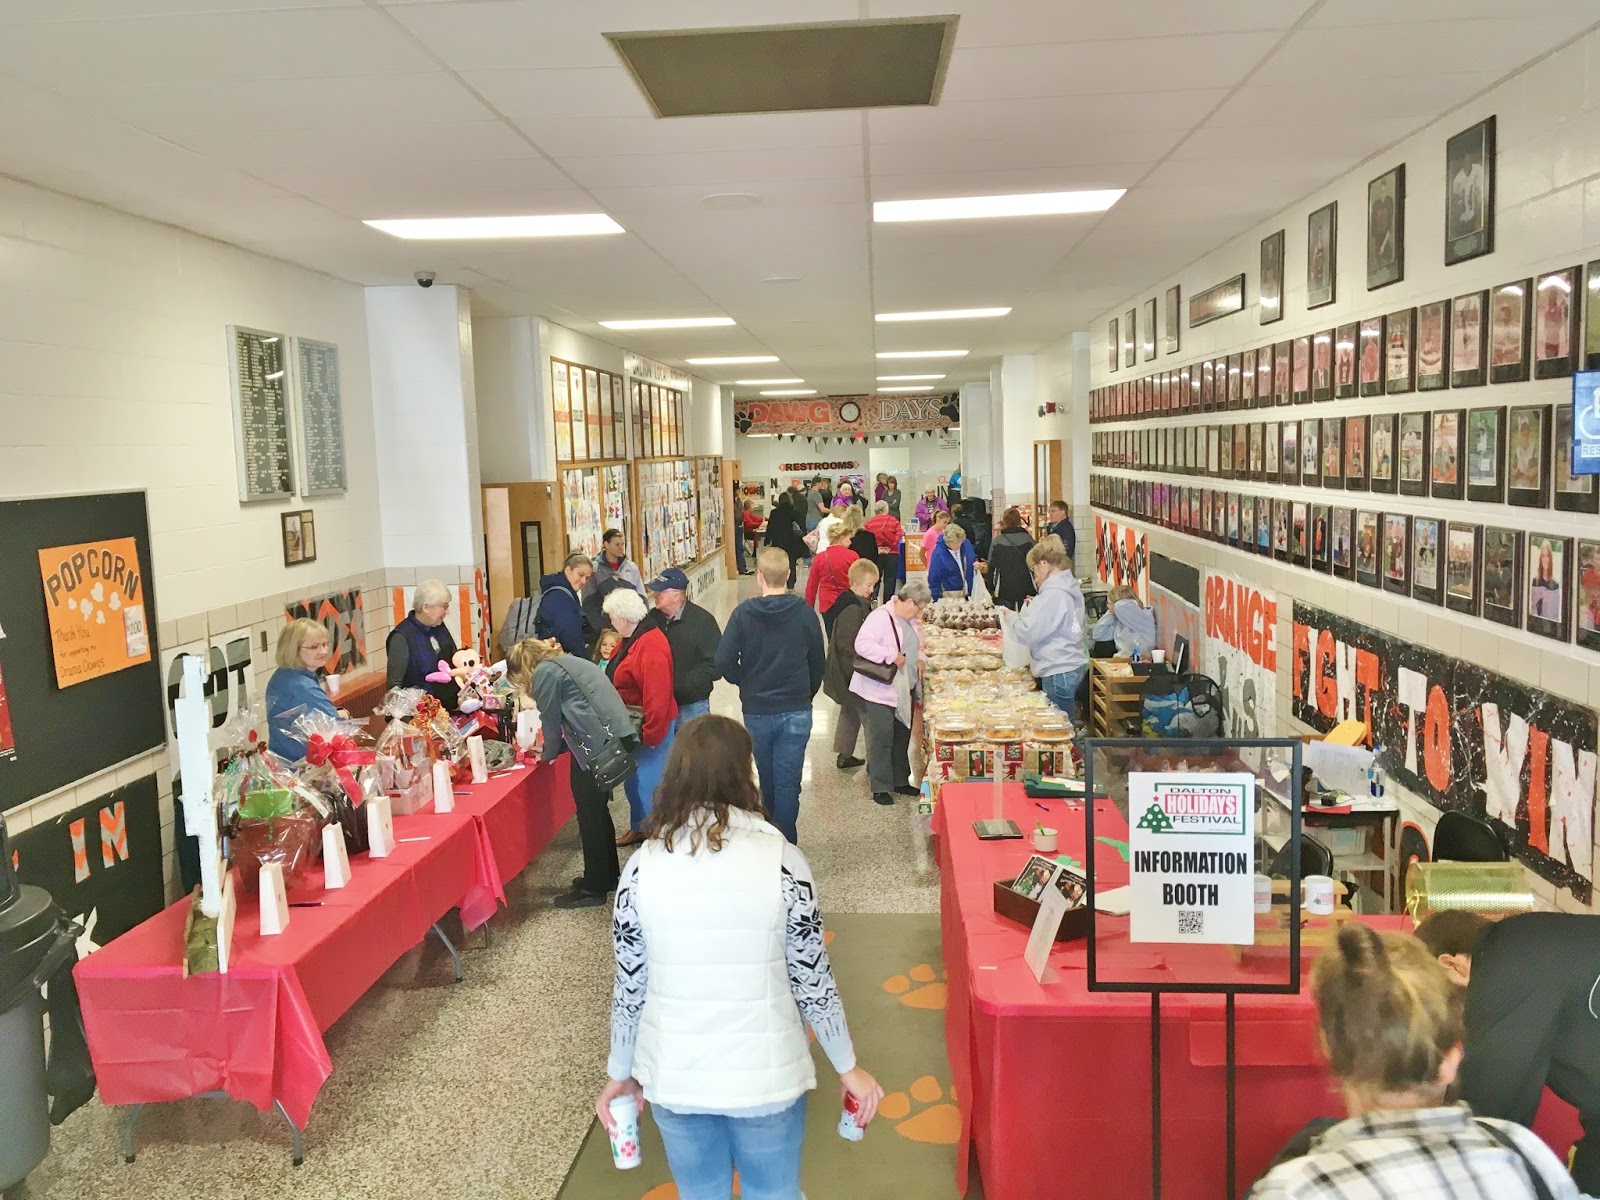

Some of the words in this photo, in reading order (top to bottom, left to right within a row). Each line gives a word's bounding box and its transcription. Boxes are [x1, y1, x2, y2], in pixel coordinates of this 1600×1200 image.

[879, 398, 943, 421] DAYS
[785, 461, 854, 471] RESTROOMS
[45, 548, 139, 607] POPCORN
[55, 625, 76, 642] Thank
[76, 625, 91, 638] You
[1205, 575, 1277, 673] ORANGE
[1293, 621, 1379, 748] FIGHT
[1398, 665, 1451, 793] TO
[1482, 701, 1597, 884] WIN
[1170, 787, 1231, 795] DALTON
[1166, 794, 1236, 815] HOLIDAYS
[1173, 815, 1241, 825] FESTIVAL
[1134, 850, 1247, 875] INFORMATION
[1163, 883, 1219, 906] BOOTH
